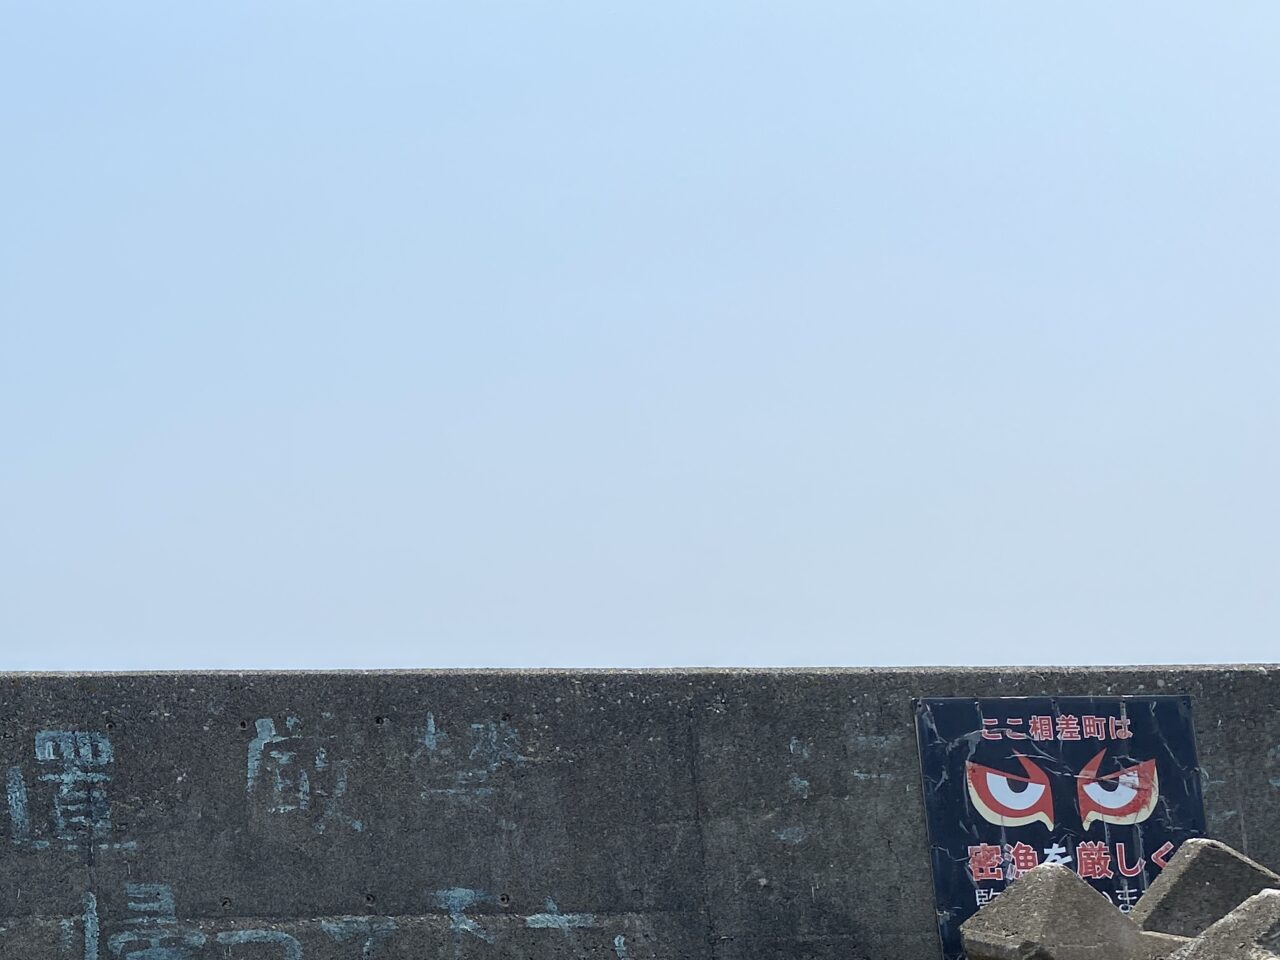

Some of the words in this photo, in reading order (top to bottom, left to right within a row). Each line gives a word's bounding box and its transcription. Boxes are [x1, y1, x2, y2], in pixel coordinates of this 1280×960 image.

[981, 715, 1134, 741] ここ相差町は
